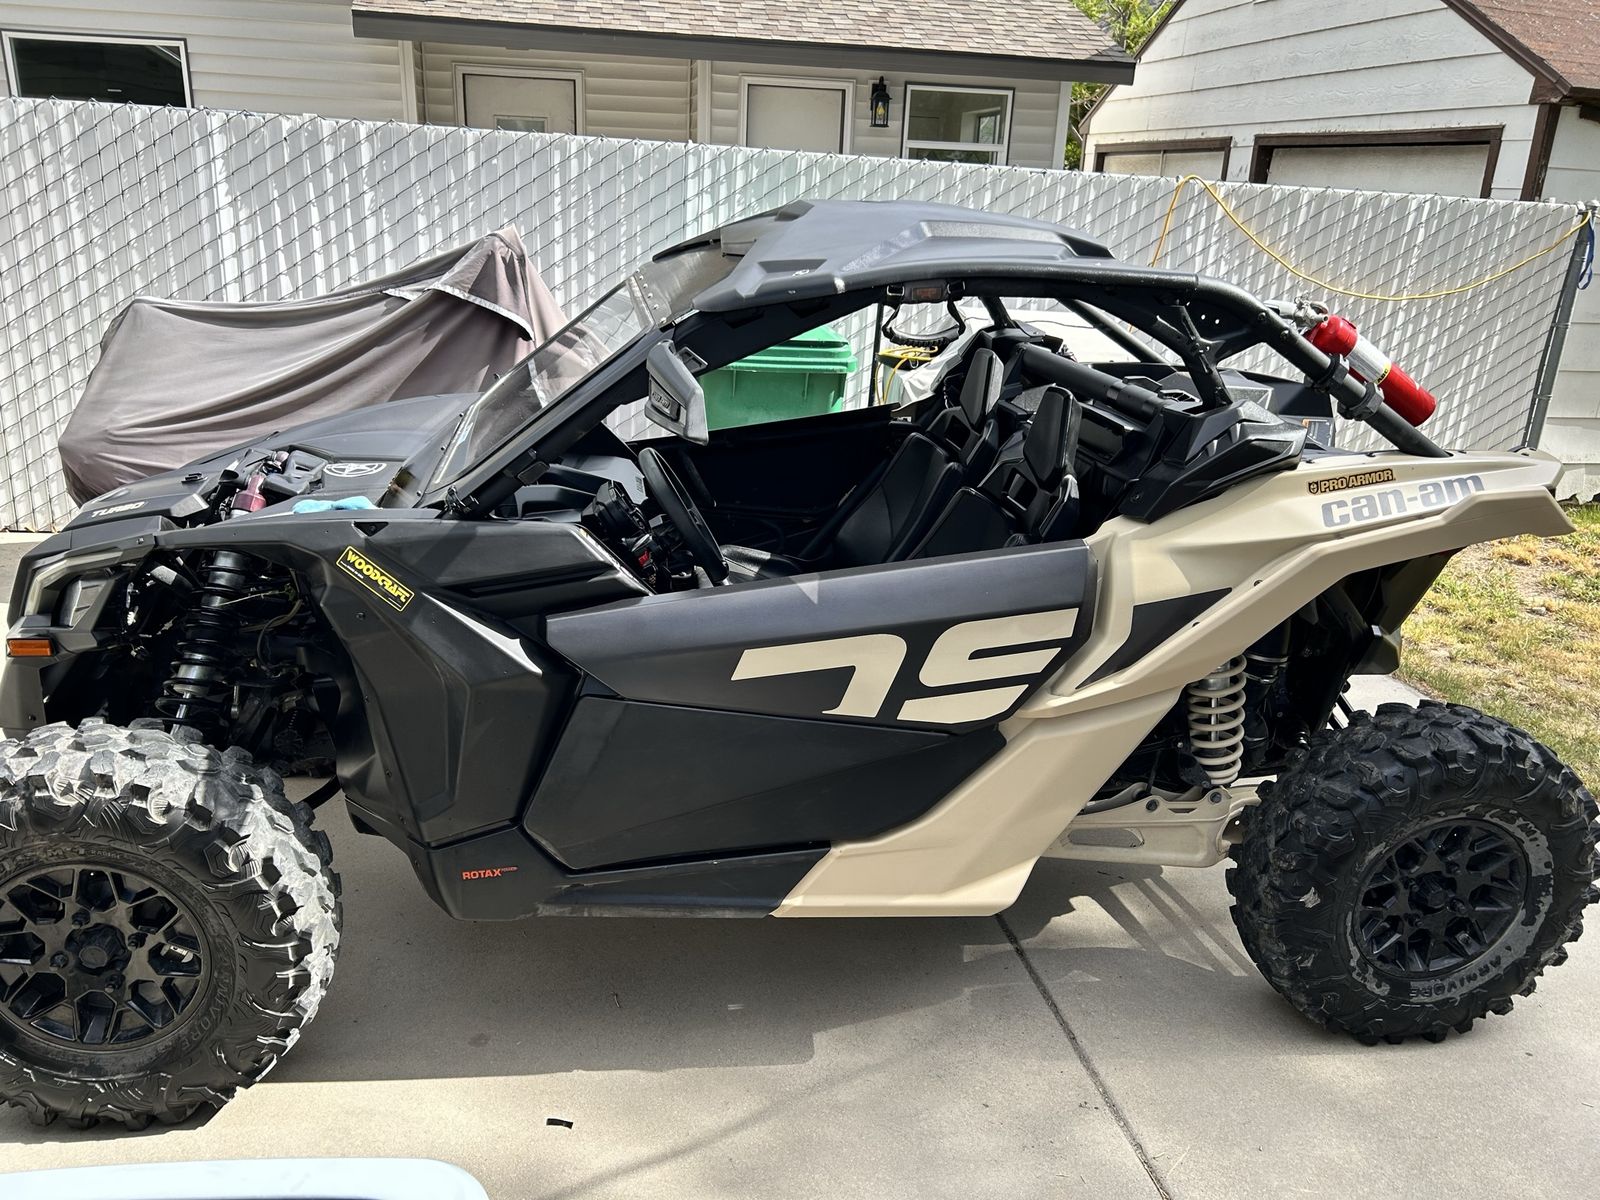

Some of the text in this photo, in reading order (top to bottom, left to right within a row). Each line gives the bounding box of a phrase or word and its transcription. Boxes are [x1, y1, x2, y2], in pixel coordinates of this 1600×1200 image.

[1320, 469, 1394, 493] PRO ARMOR
[91, 501, 146, 518] TURBO
[1321, 475, 1485, 528] can-am
[346, 550, 410, 603] WOODCRAFT
[462, 868, 501, 880] ROTAX
